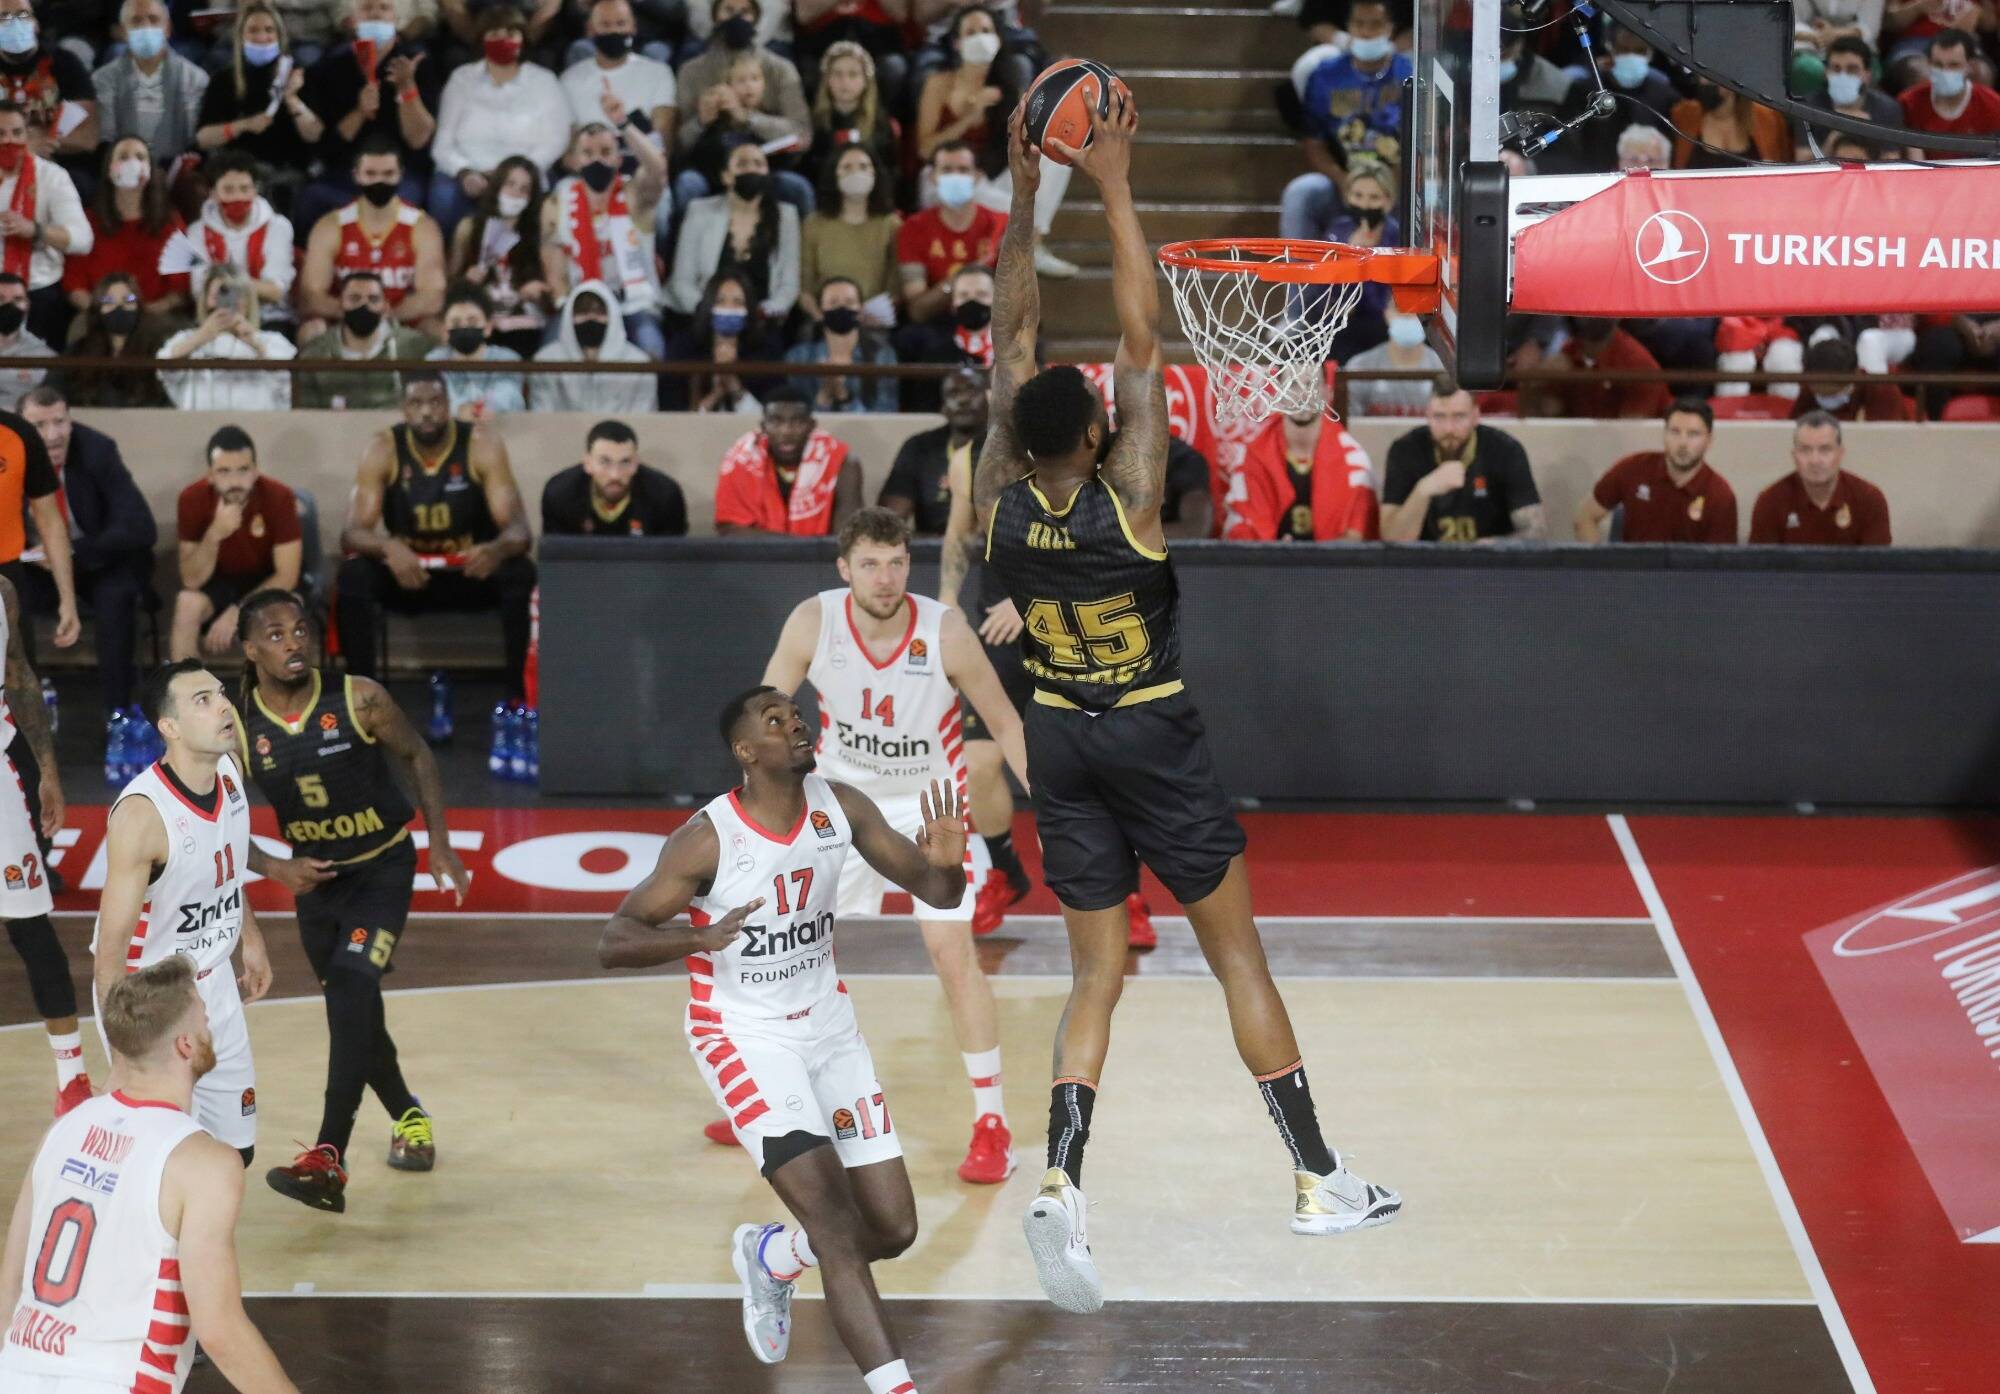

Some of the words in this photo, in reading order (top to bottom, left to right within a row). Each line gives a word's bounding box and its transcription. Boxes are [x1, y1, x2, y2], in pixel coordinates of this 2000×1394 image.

[1728, 233, 1906, 268] TURKISH
[1918, 237, 2000, 269] AIR
[414, 503, 450, 530] 10
[1026, 521, 1077, 550] HALL
[1438, 516, 1477, 541] 20
[1024, 591, 1151, 669] 45
[861, 687, 895, 728] 14
[295, 773, 330, 808] 5
[285, 806, 385, 842] EDCOM
[22, 852, 43, 890] 2
[214, 842, 235, 889] 11
[773, 866, 814, 916] 17
[368, 927, 397, 969] 5
[855, 1092, 892, 1140] 17
[33, 1196, 98, 1308] 0
